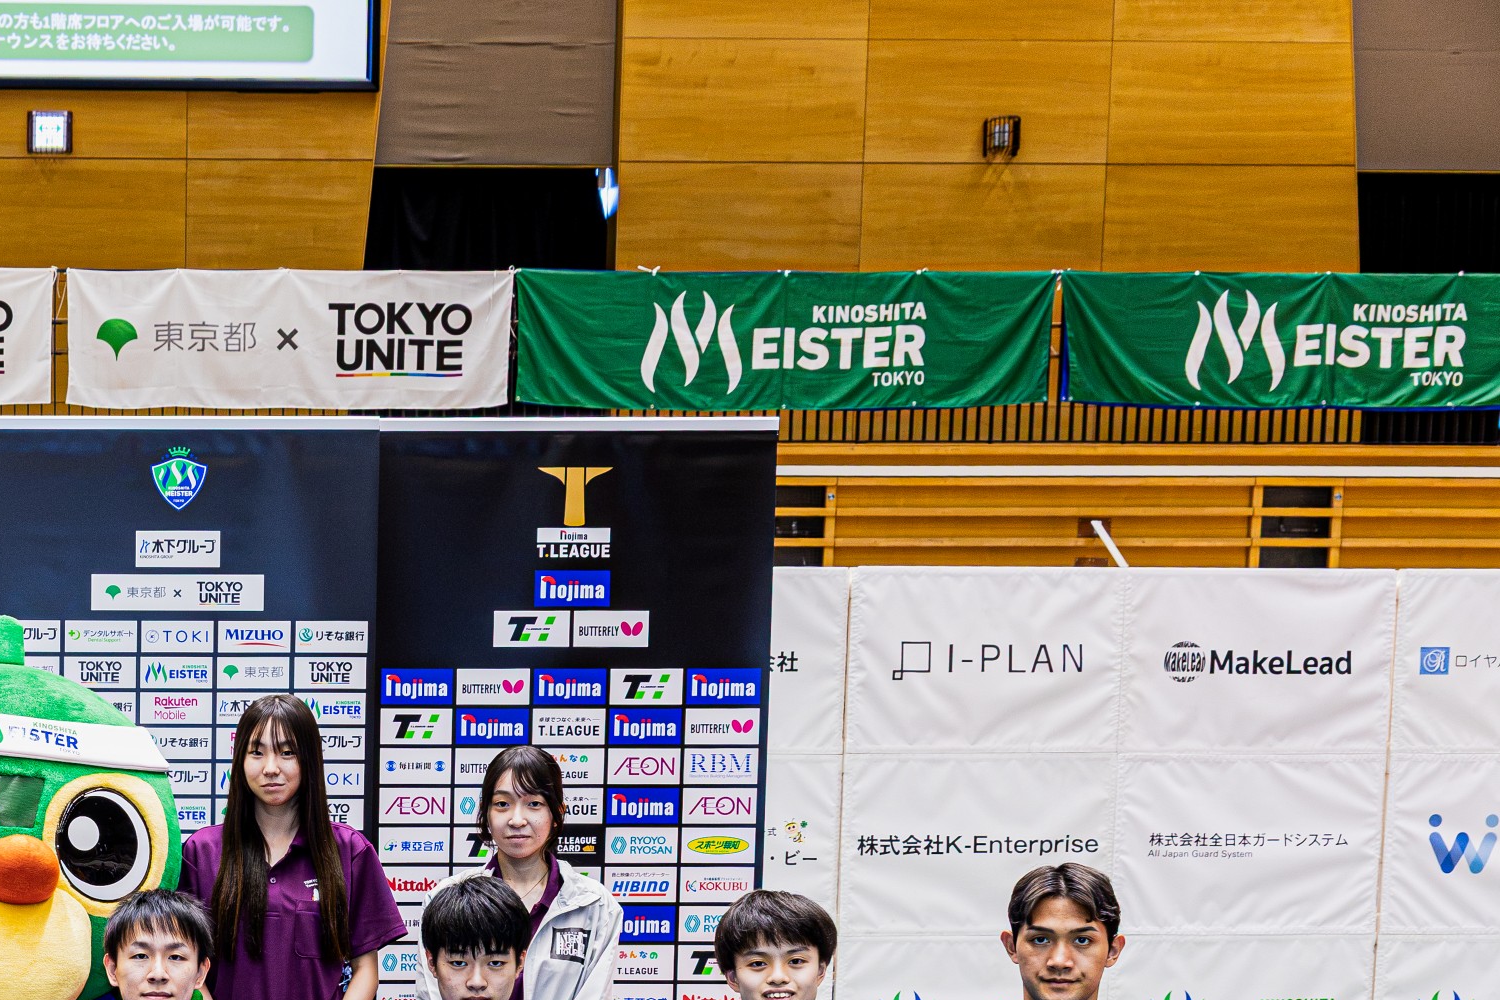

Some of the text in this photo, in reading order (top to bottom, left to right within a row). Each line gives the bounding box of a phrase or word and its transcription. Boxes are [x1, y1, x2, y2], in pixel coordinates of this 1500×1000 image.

[812, 303, 927, 324] KINOSHITA
[1353, 303, 1468, 323] KINOSHITA
[328, 303, 473, 336] TOKYO
[153, 321, 258, 352] 東京都
[336, 339, 462, 373] UNITE
[871, 371, 925, 387] TOKYO
[1410, 372, 1464, 388] TOKYO
[152, 539, 215, 554] 木下グループ
[537, 544, 611, 558] T.LEAGUE
[127, 586, 166, 598] 東京都
[197, 581, 243, 592] TOKYO
[199, 593, 240, 604] UNITE
[83, 629, 134, 638] デンタルサポート
[163, 630, 208, 642] TOKI
[225, 629, 283, 641] MIZUHO
[315, 630, 365, 642] りそな銀行
[578, 625, 619, 637] BUTTERFLY
[947, 643, 1083, 673] I-PLAN
[1209, 650, 1351, 674] MakeLead
[78, 661, 122, 671] TOKYO
[309, 662, 352, 672] TOKYO
[80, 672, 119, 682] UNITE
[244, 666, 284, 678] 東京都
[311, 672, 350, 683] UNITE
[462, 683, 501, 694] BUTTERFLY
[154, 696, 198, 707] Rakuten
[154, 710, 186, 720] Mobile
[538, 725, 600, 736] T.LEAGUE
[690, 723, 730, 734] BUTTERFLY
[159, 737, 208, 747] りそな銀行
[399, 761, 432, 770] 毎日新聞
[690, 753, 752, 772] RBM
[630, 836, 666, 844] RYOYO
[695, 841, 740, 849] スポーツ報知
[857, 834, 1099, 856] 株式会社K-Enterprise
[1150, 833, 1348, 847] 株式会社全日本ガードシステム
[400, 841, 444, 852] 東亞合成
[630, 846, 672, 854] RYOSAN
[700, 882, 748, 891] KOKUBU
[619, 951, 658, 959] みんなの
